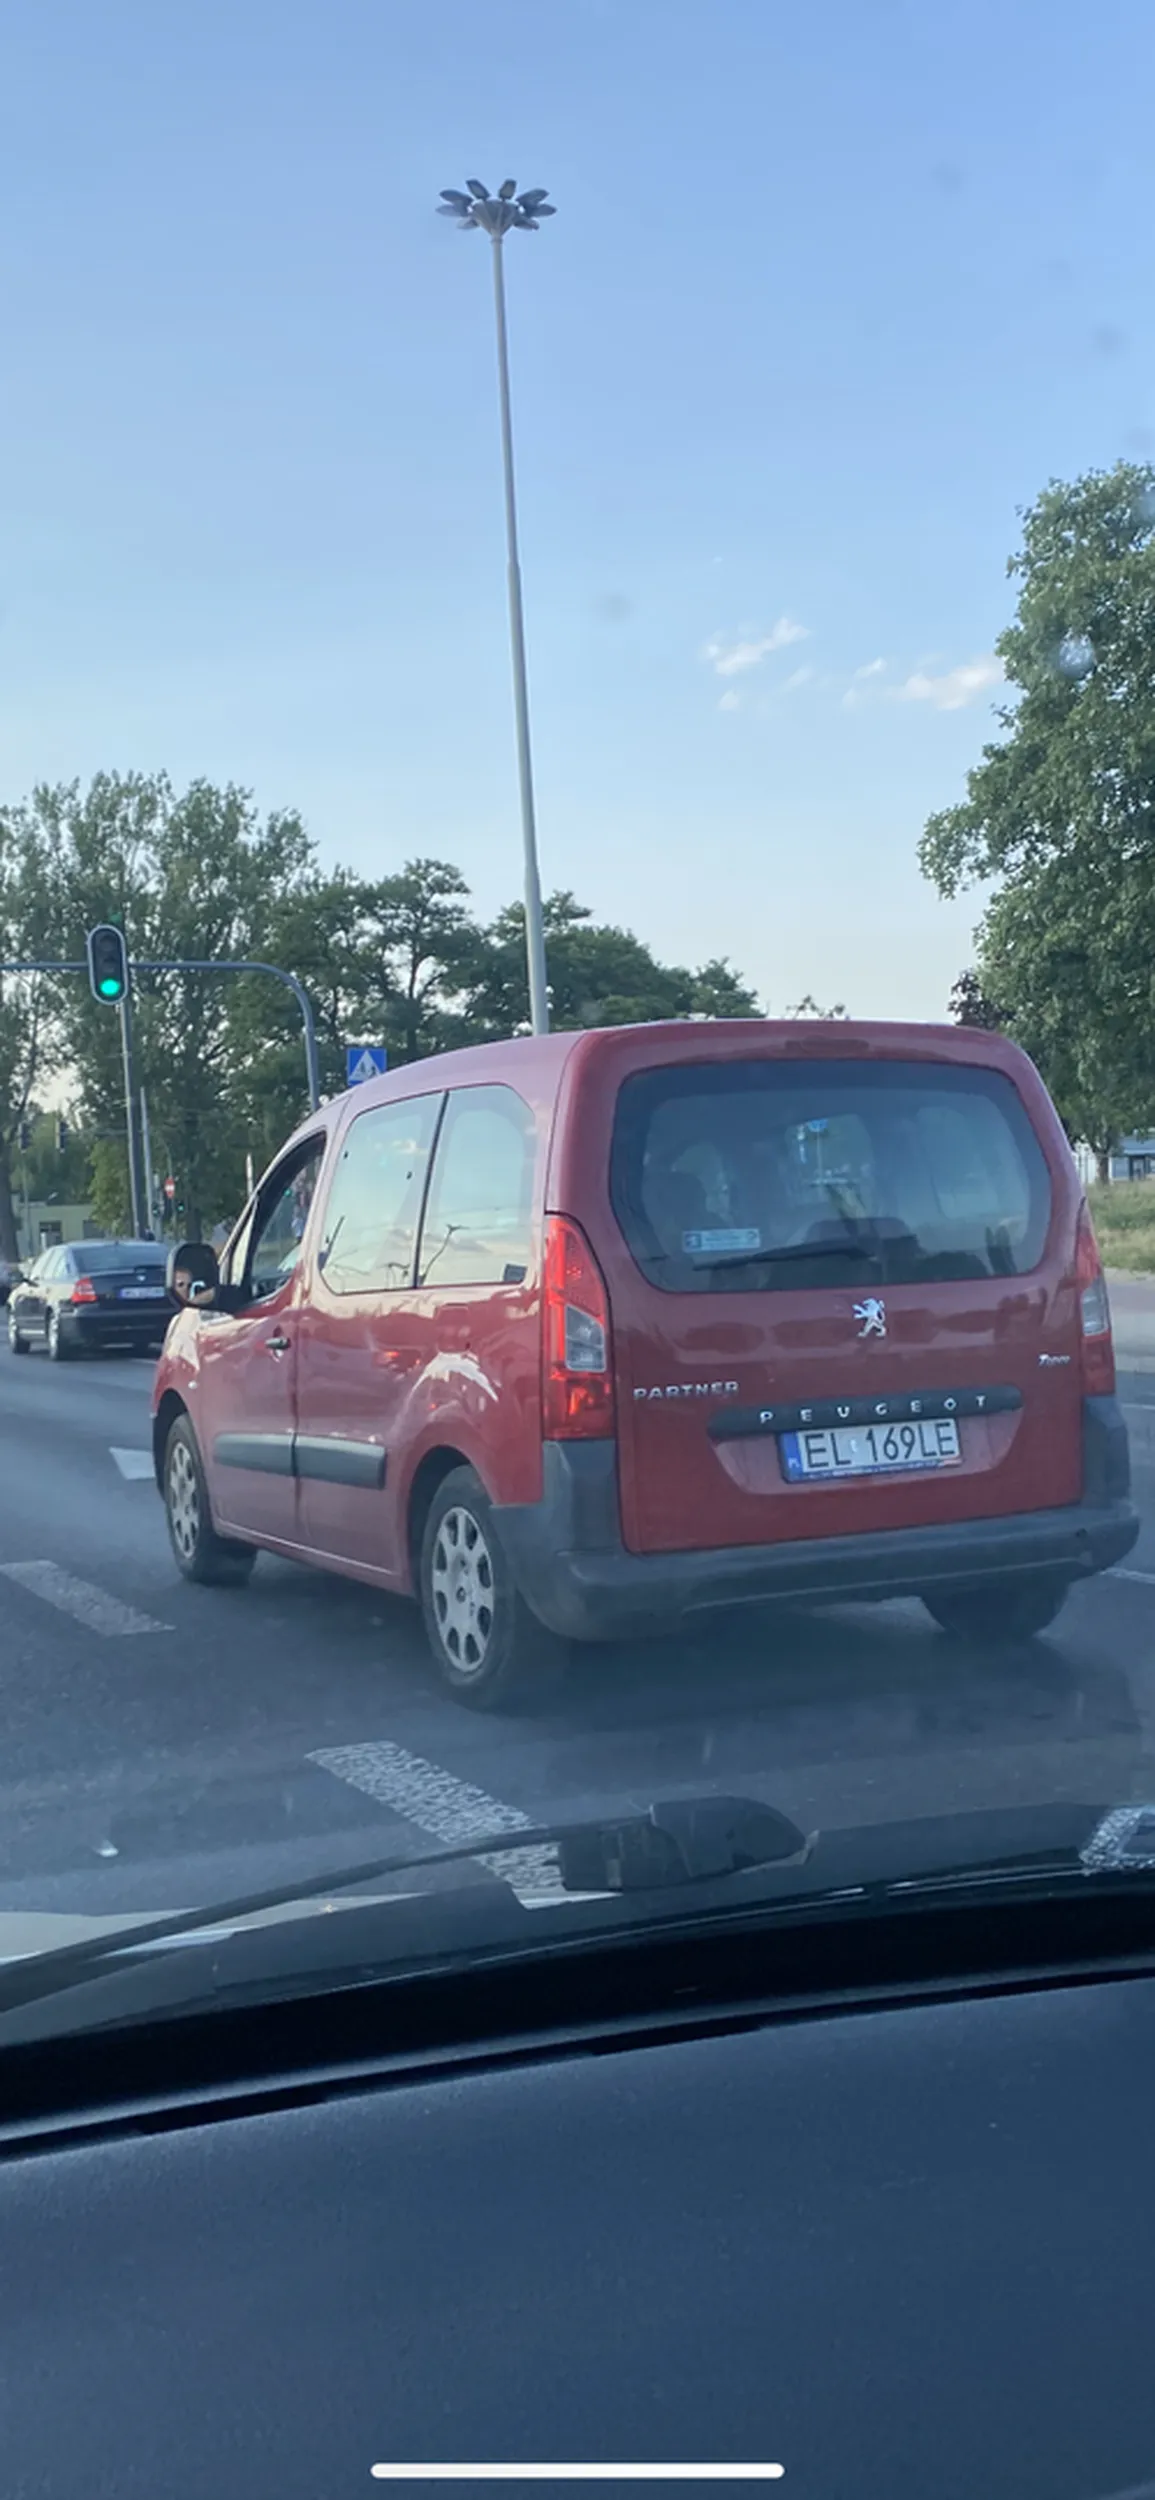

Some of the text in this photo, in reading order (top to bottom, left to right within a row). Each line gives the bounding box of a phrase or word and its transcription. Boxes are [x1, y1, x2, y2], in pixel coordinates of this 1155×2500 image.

[633, 1381, 739, 1400] PARTNER
[760, 1395, 986, 1424] PEUGEOT
[803, 1421, 956, 1468] EL 169LE
